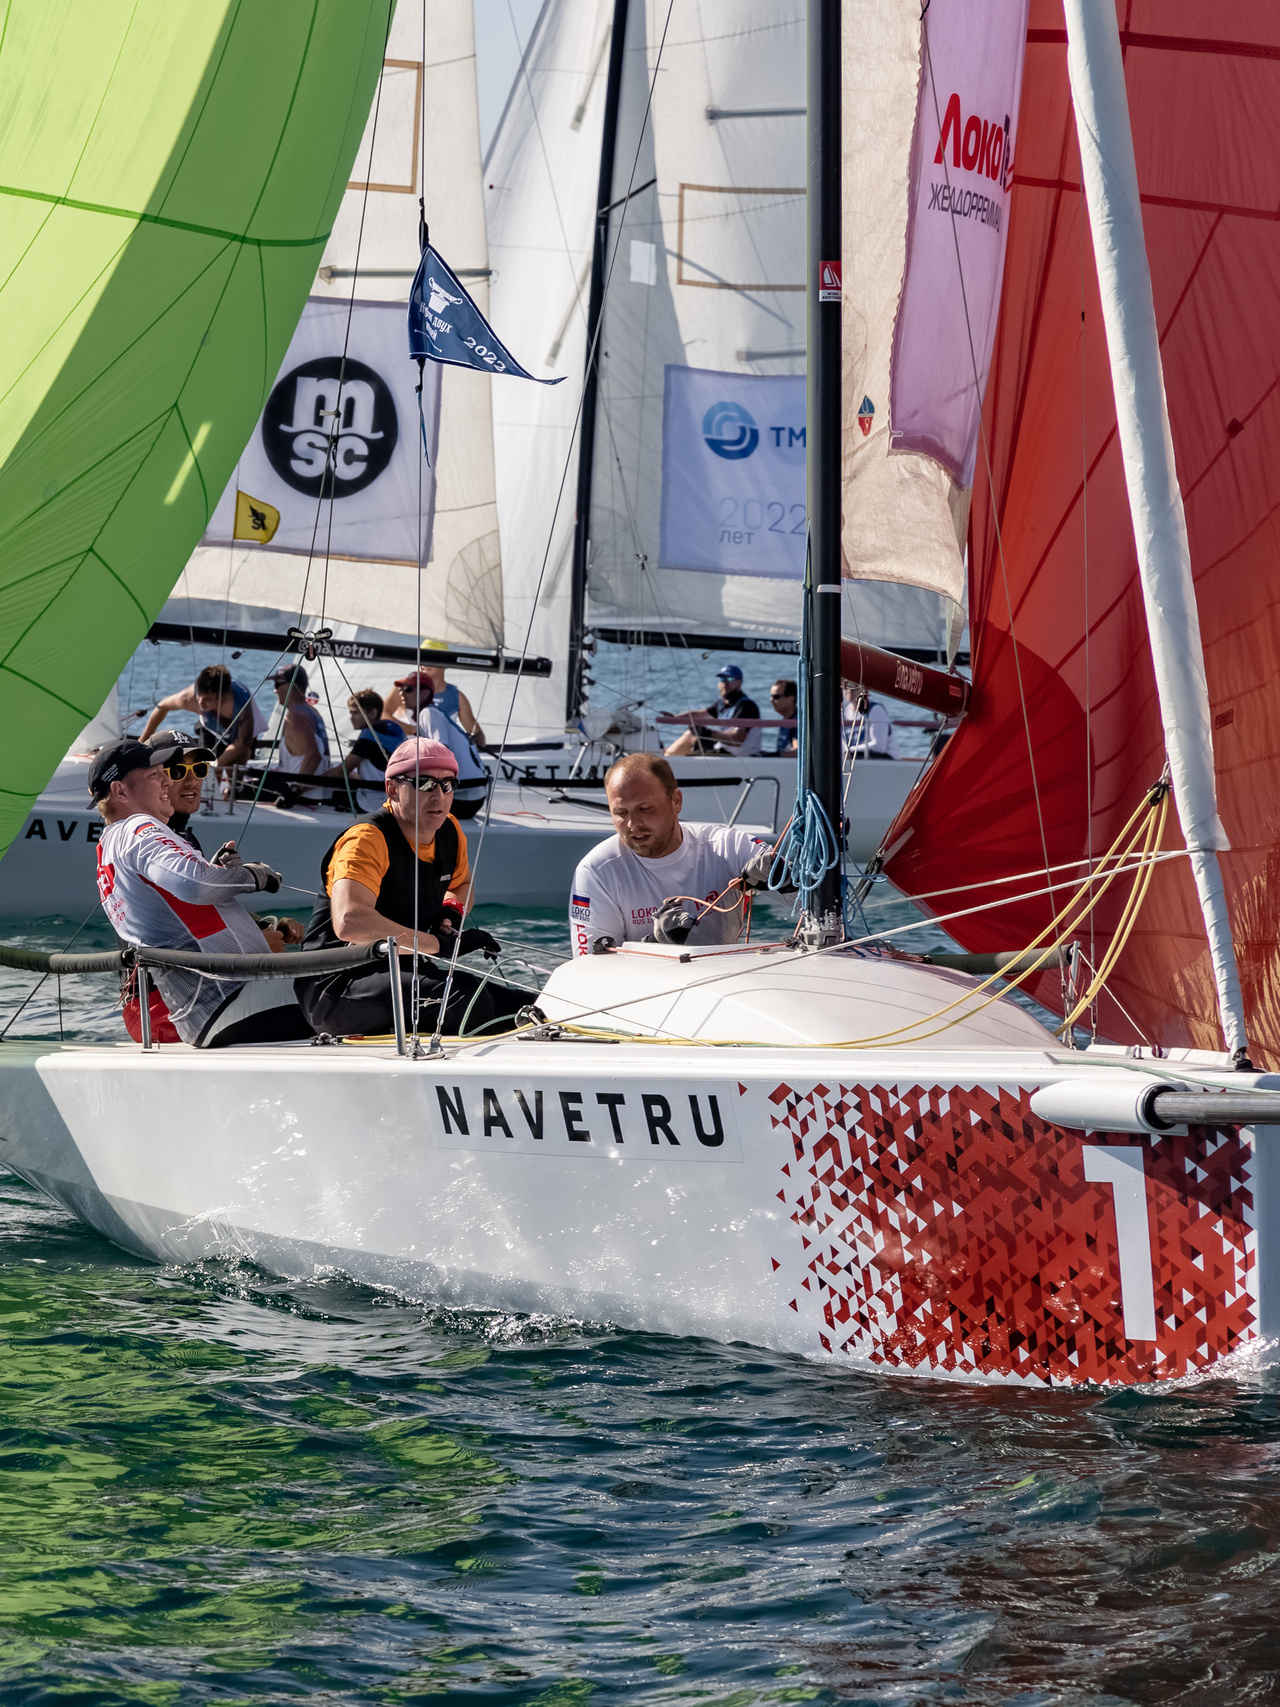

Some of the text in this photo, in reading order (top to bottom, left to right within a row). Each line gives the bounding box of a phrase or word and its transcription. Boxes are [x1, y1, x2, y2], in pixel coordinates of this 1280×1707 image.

[463, 336, 507, 372] 2022
[719, 530, 754, 545] лет
[168, 729, 191, 744] LA
[572, 906, 591, 917] LOKO
[435, 1085, 725, 1148] NAVETRU
[1082, 1145, 1157, 1341] 1
